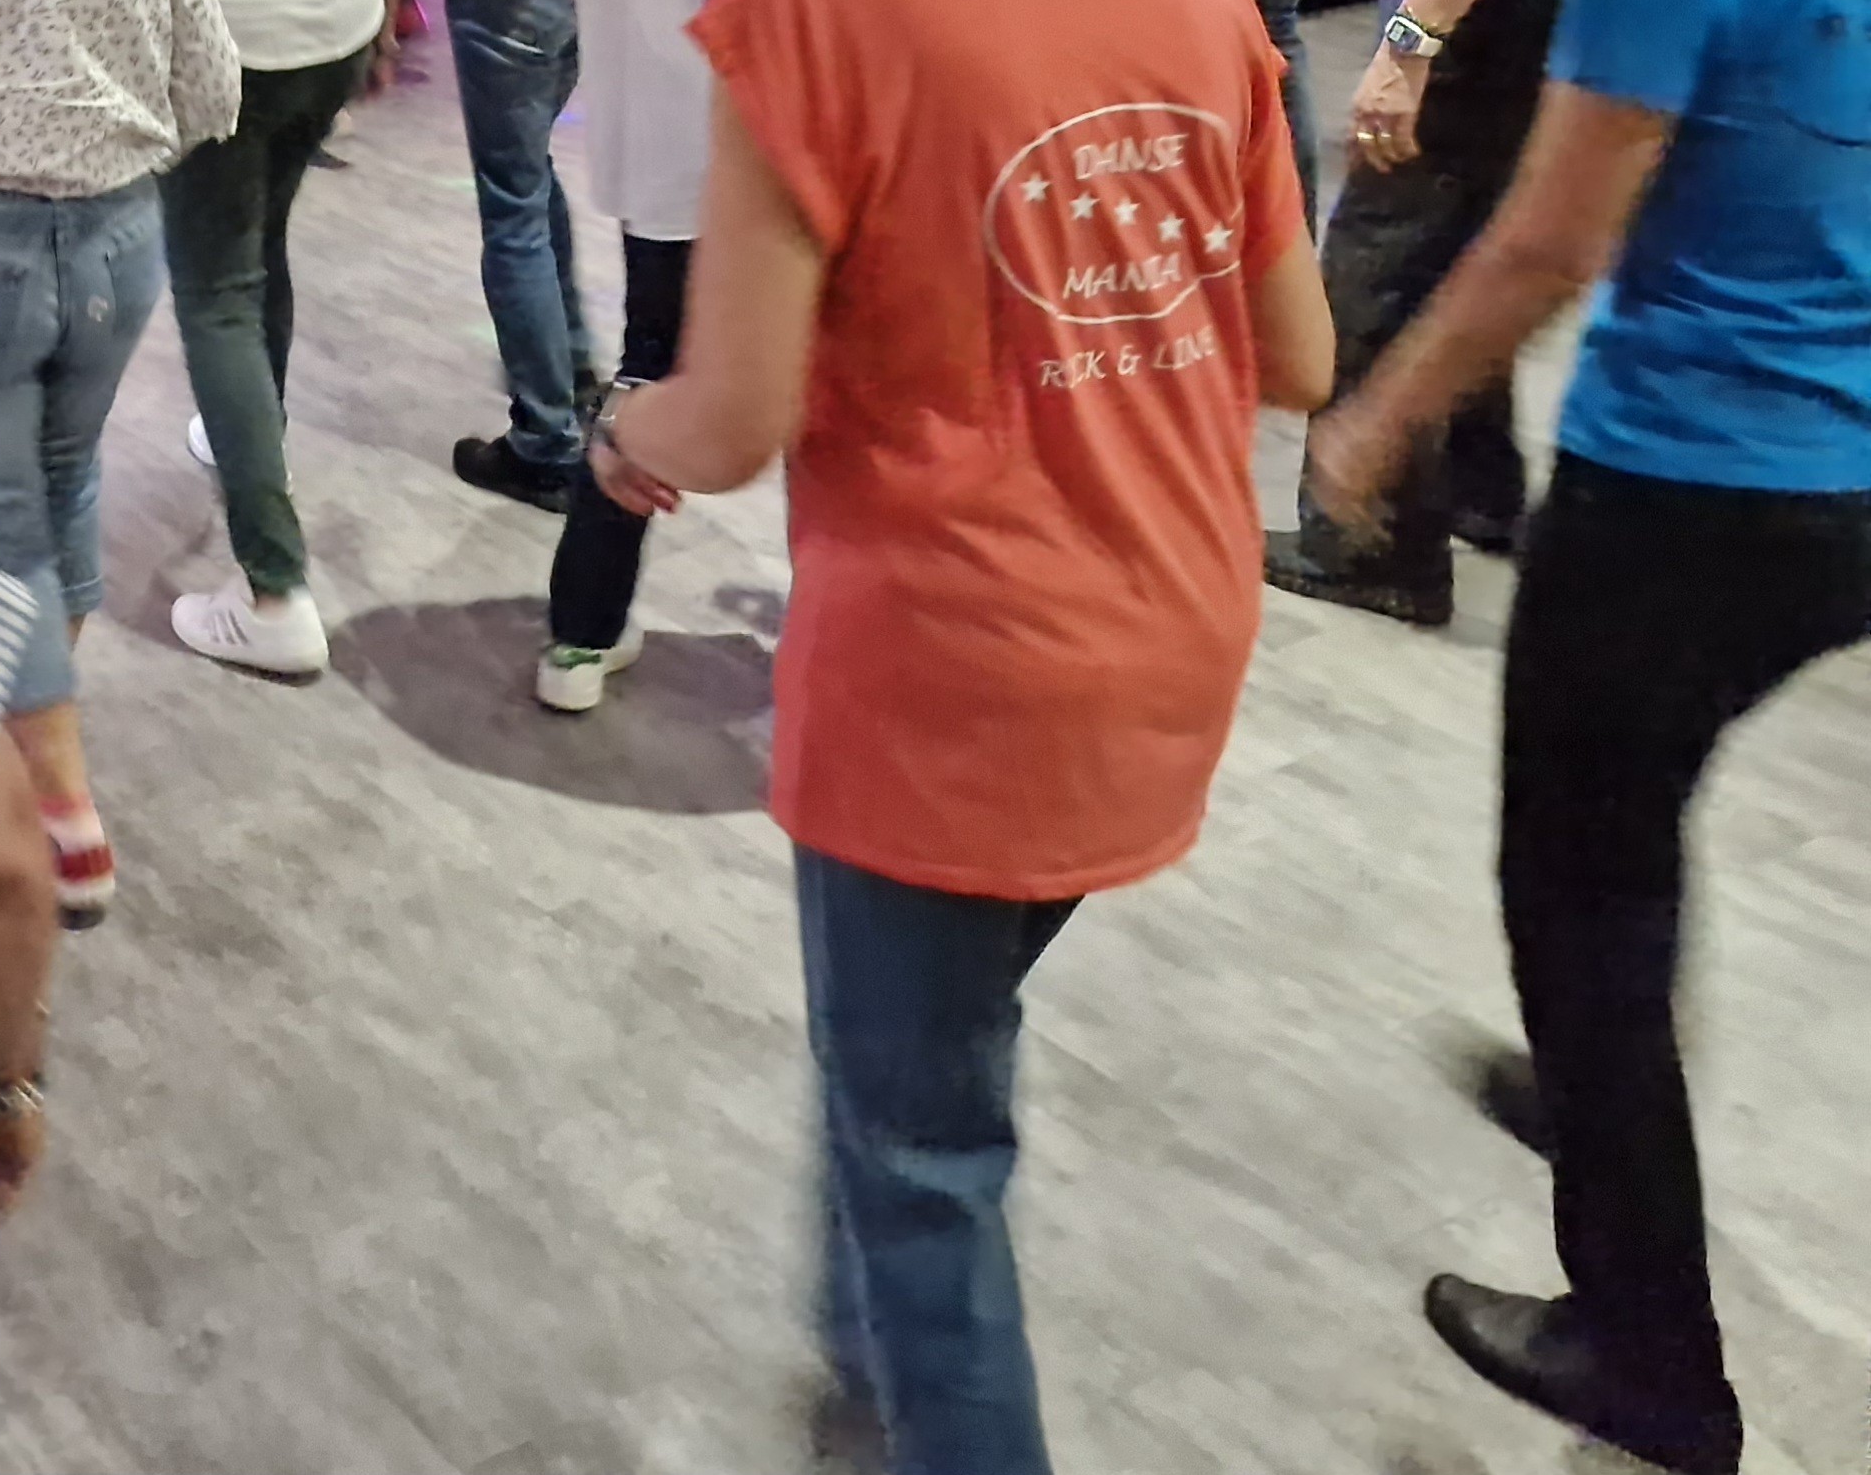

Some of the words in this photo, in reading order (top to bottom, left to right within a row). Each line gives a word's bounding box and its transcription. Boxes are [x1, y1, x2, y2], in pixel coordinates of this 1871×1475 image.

[1072, 133, 1190, 181] DANSE
[1040, 349, 1107, 390] RCK
[1116, 344, 1143, 376] &
